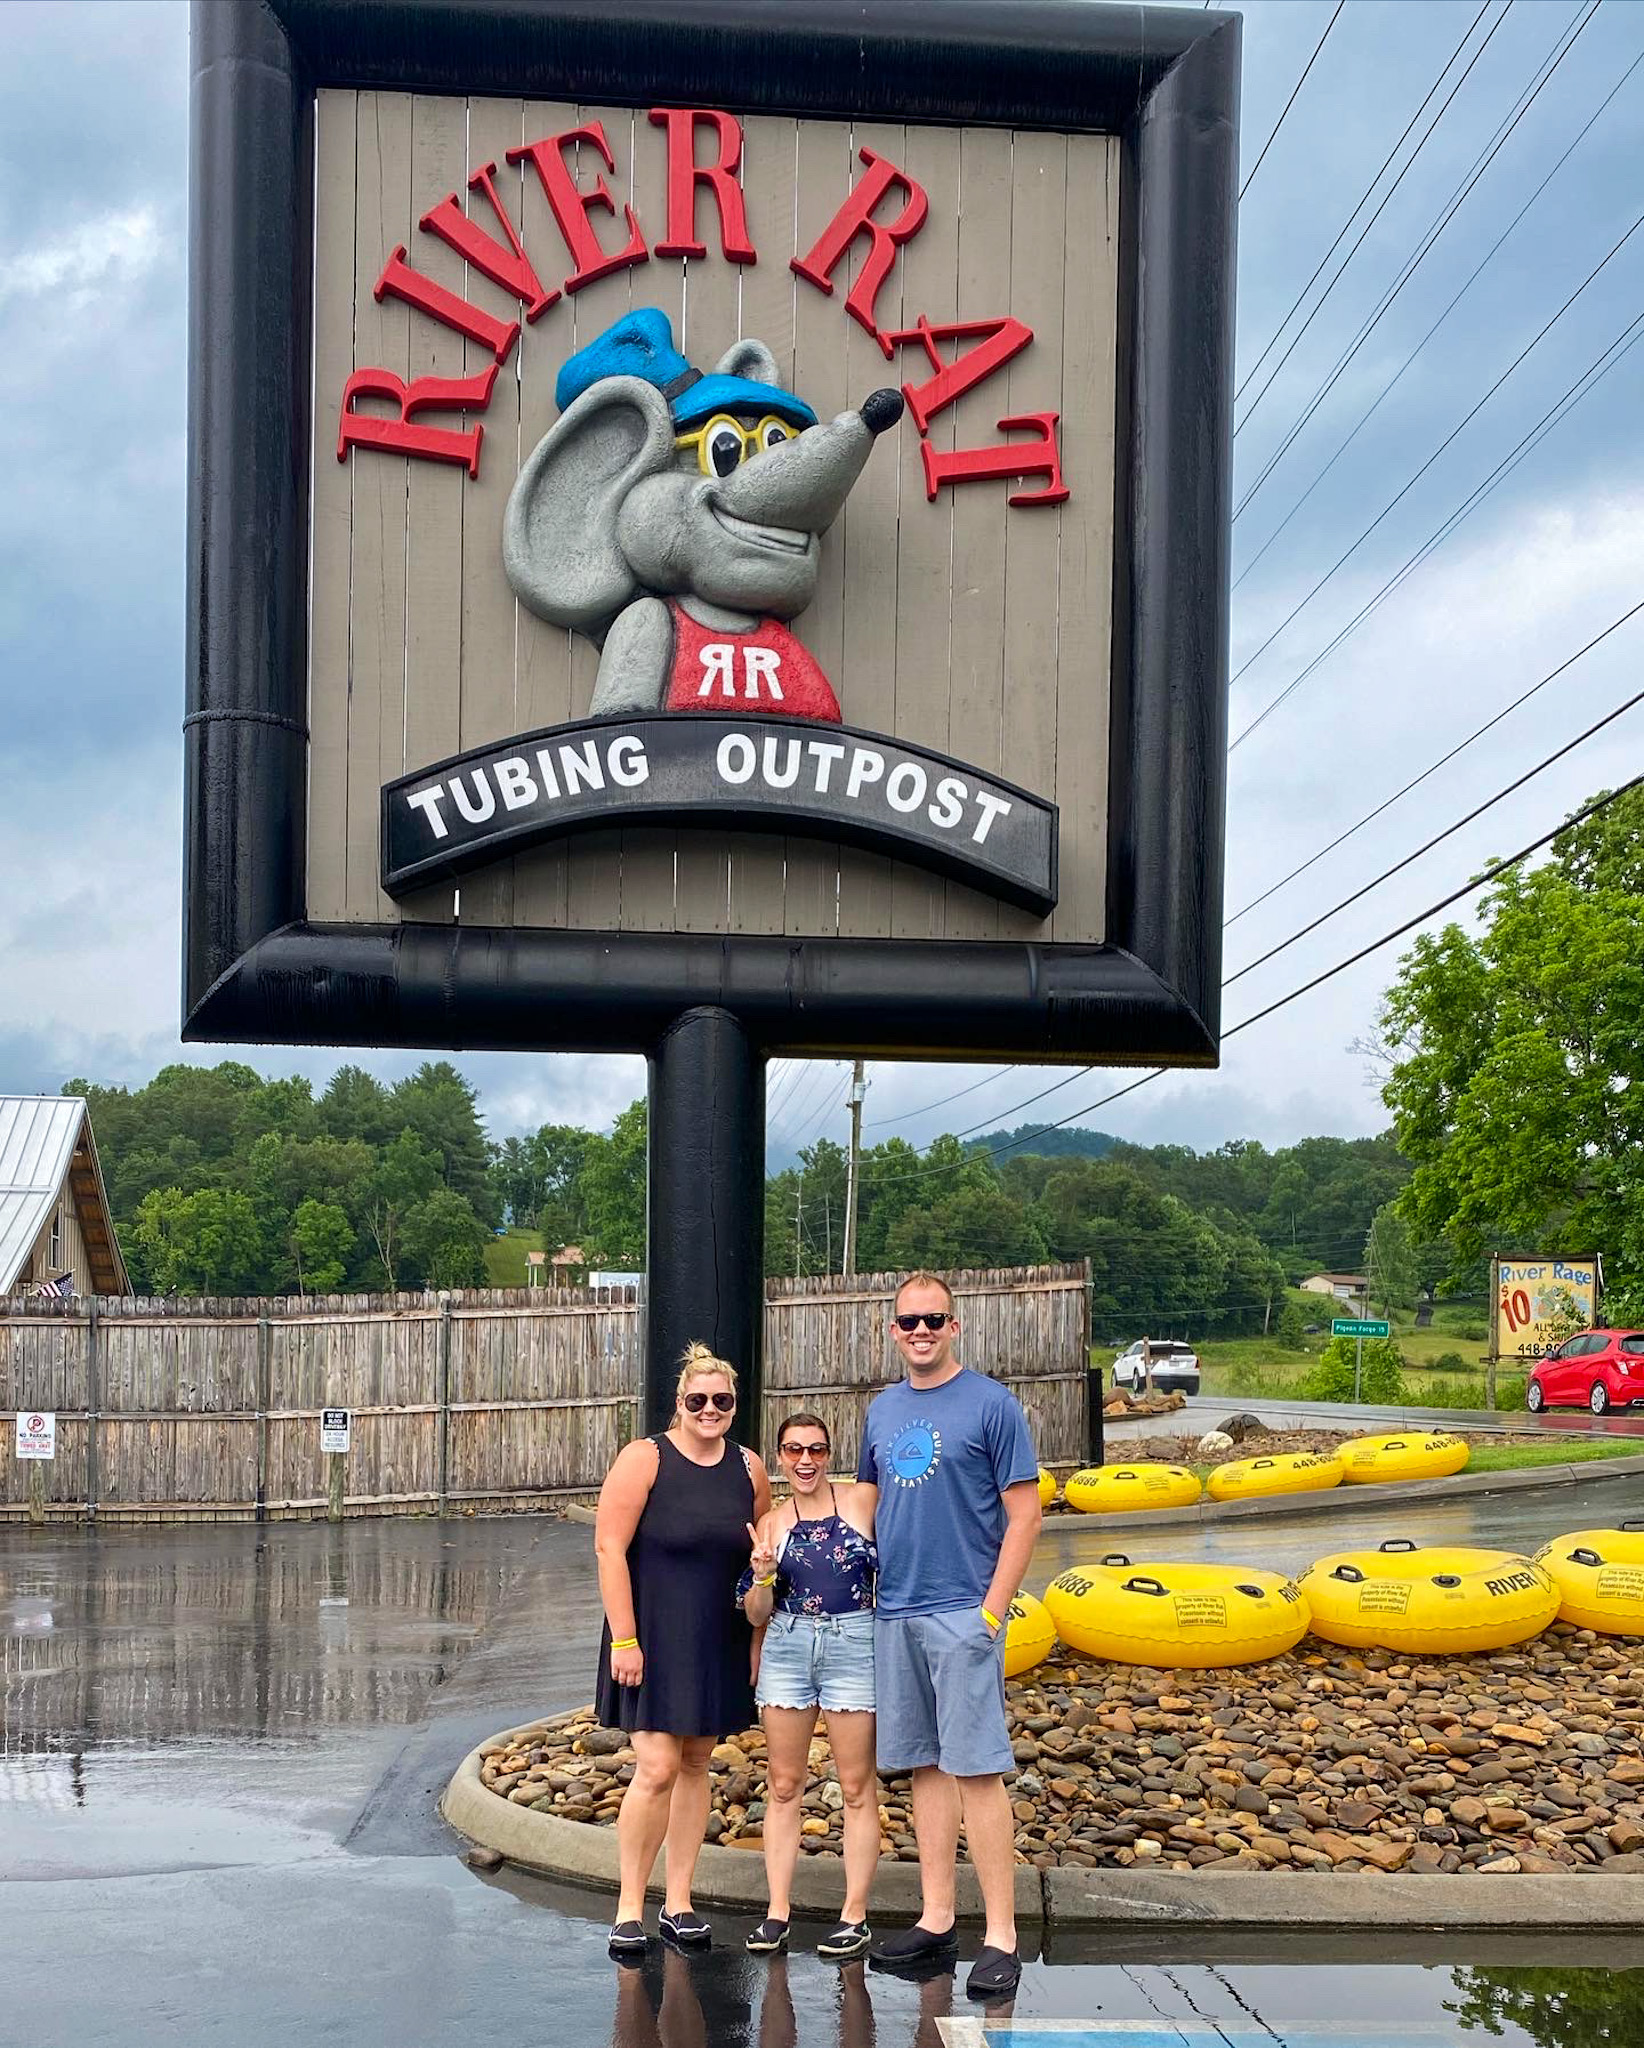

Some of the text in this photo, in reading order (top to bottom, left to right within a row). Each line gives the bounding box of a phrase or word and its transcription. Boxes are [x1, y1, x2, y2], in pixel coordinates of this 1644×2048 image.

[336, 108, 1071, 507] RIVER RAT
[406, 733, 1013, 844] TUBING OUTPOST
[1500, 1261, 1592, 1286] River Rage
[1539, 1333, 1545, 1342] &
[1484, 1572, 1538, 1596] RIVER
